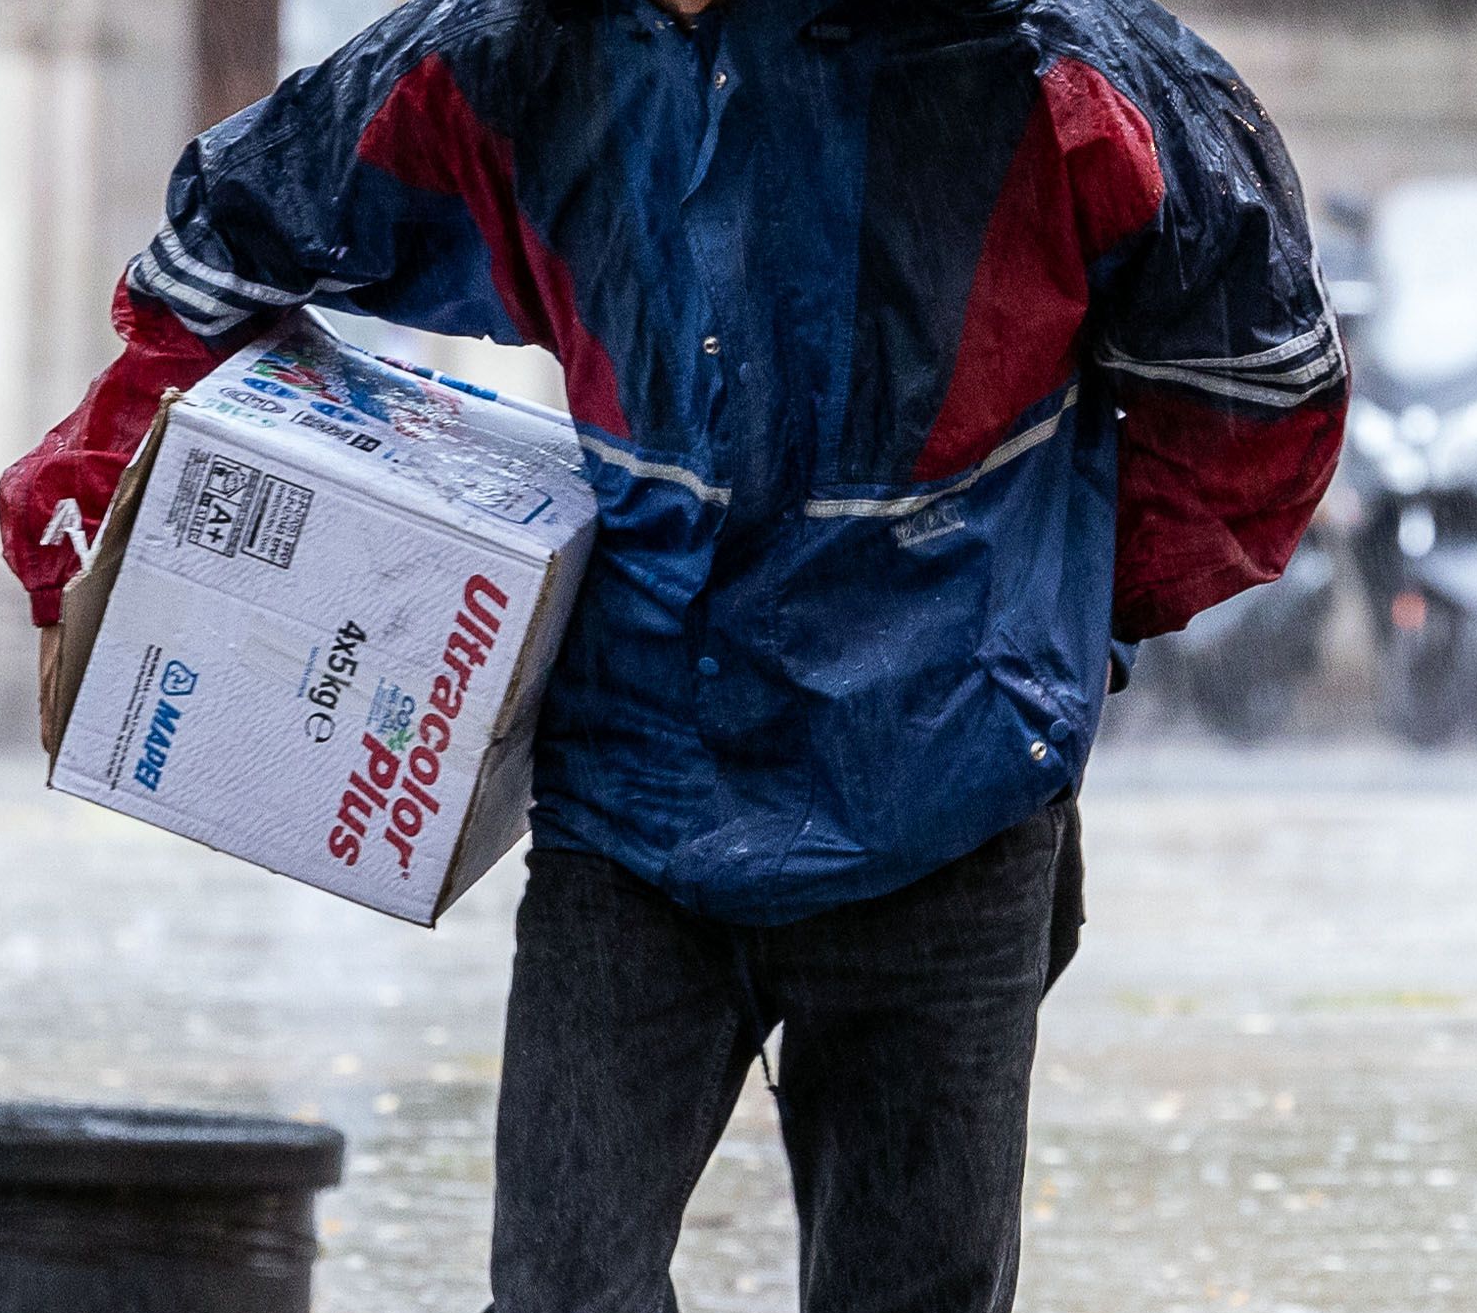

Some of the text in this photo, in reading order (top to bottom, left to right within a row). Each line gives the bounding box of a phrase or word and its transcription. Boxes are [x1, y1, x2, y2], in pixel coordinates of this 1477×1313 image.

[133, 698, 183, 792] MAPEI
[383, 574, 510, 869] Ultracolor
[327, 733, 401, 866] Plus
